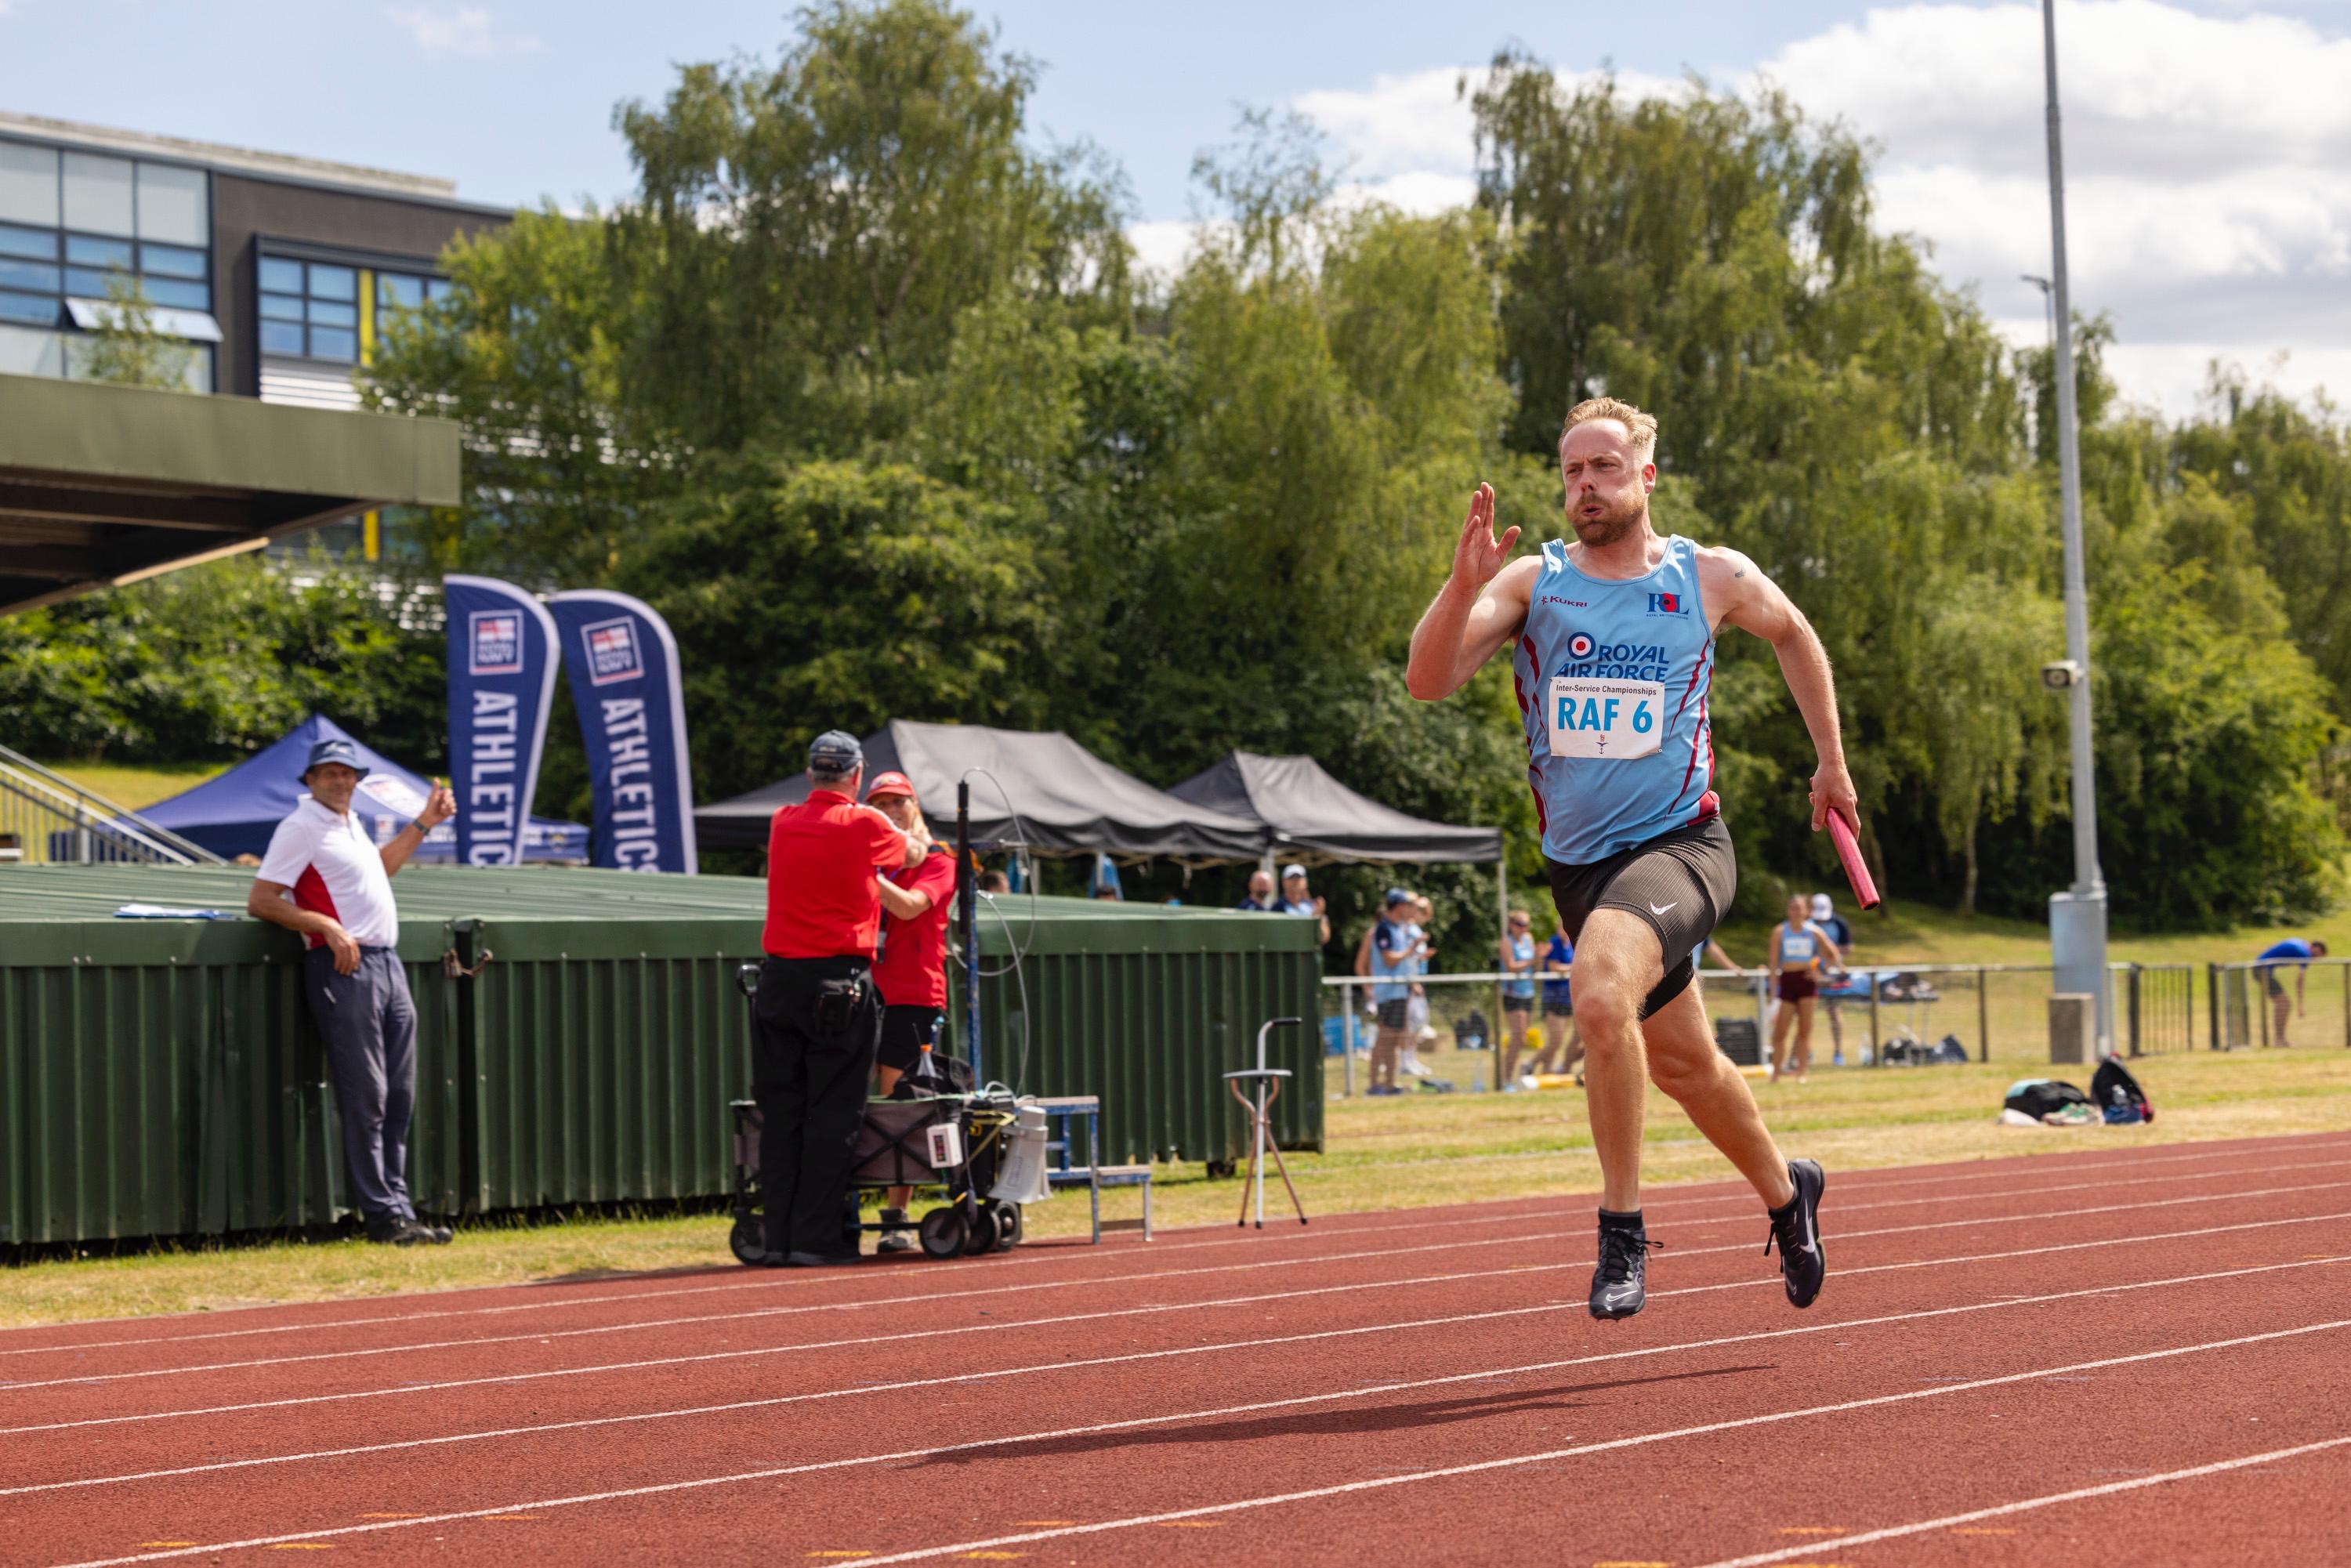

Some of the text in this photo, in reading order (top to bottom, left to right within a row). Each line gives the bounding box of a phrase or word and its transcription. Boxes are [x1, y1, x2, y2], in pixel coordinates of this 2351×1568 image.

[1550, 596, 1588, 607] KUKRI
[1598, 644, 1669, 664] ROYAL
[1555, 663, 1669, 683] AIR FORCE
[1556, 684, 1657, 697] Inter-Service Championships
[1558, 697, 1653, 733] RAF 6
[600, 697, 660, 872] ATHLETIC
